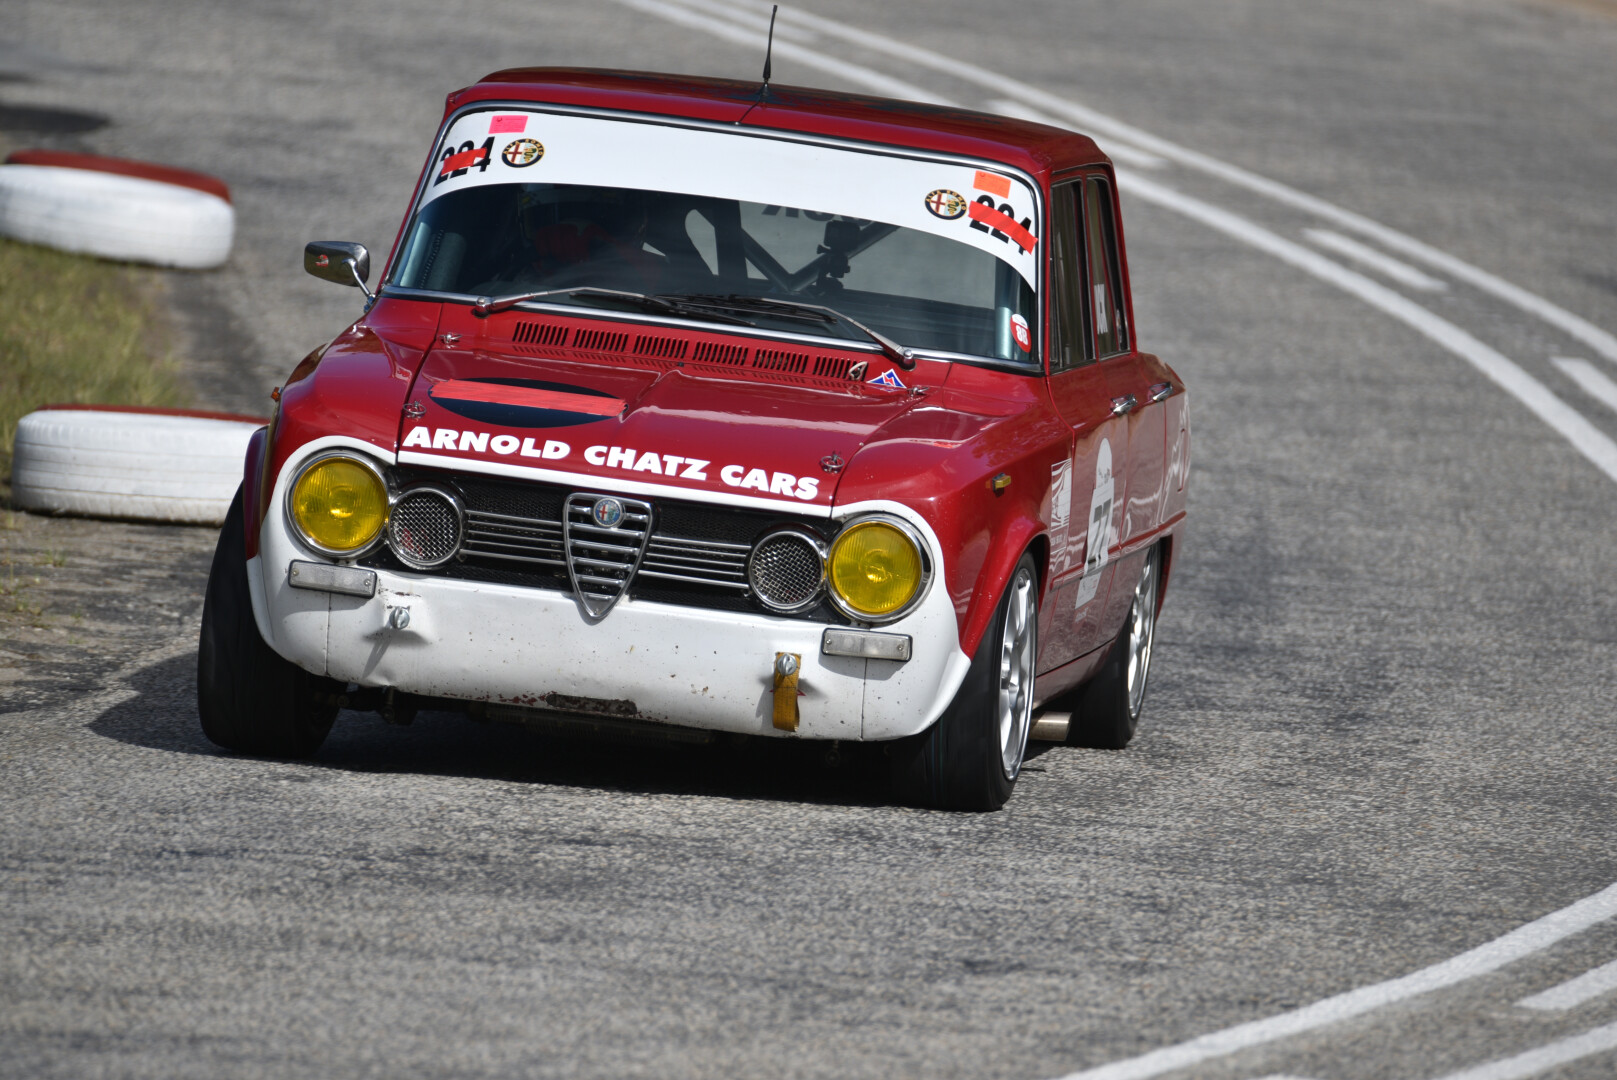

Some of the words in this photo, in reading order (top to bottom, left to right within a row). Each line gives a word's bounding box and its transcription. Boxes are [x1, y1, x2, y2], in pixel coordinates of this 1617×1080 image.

[402, 426, 571, 460] ARNOLD
[583, 445, 711, 481] CHATZ
[720, 464, 820, 500] CARS
